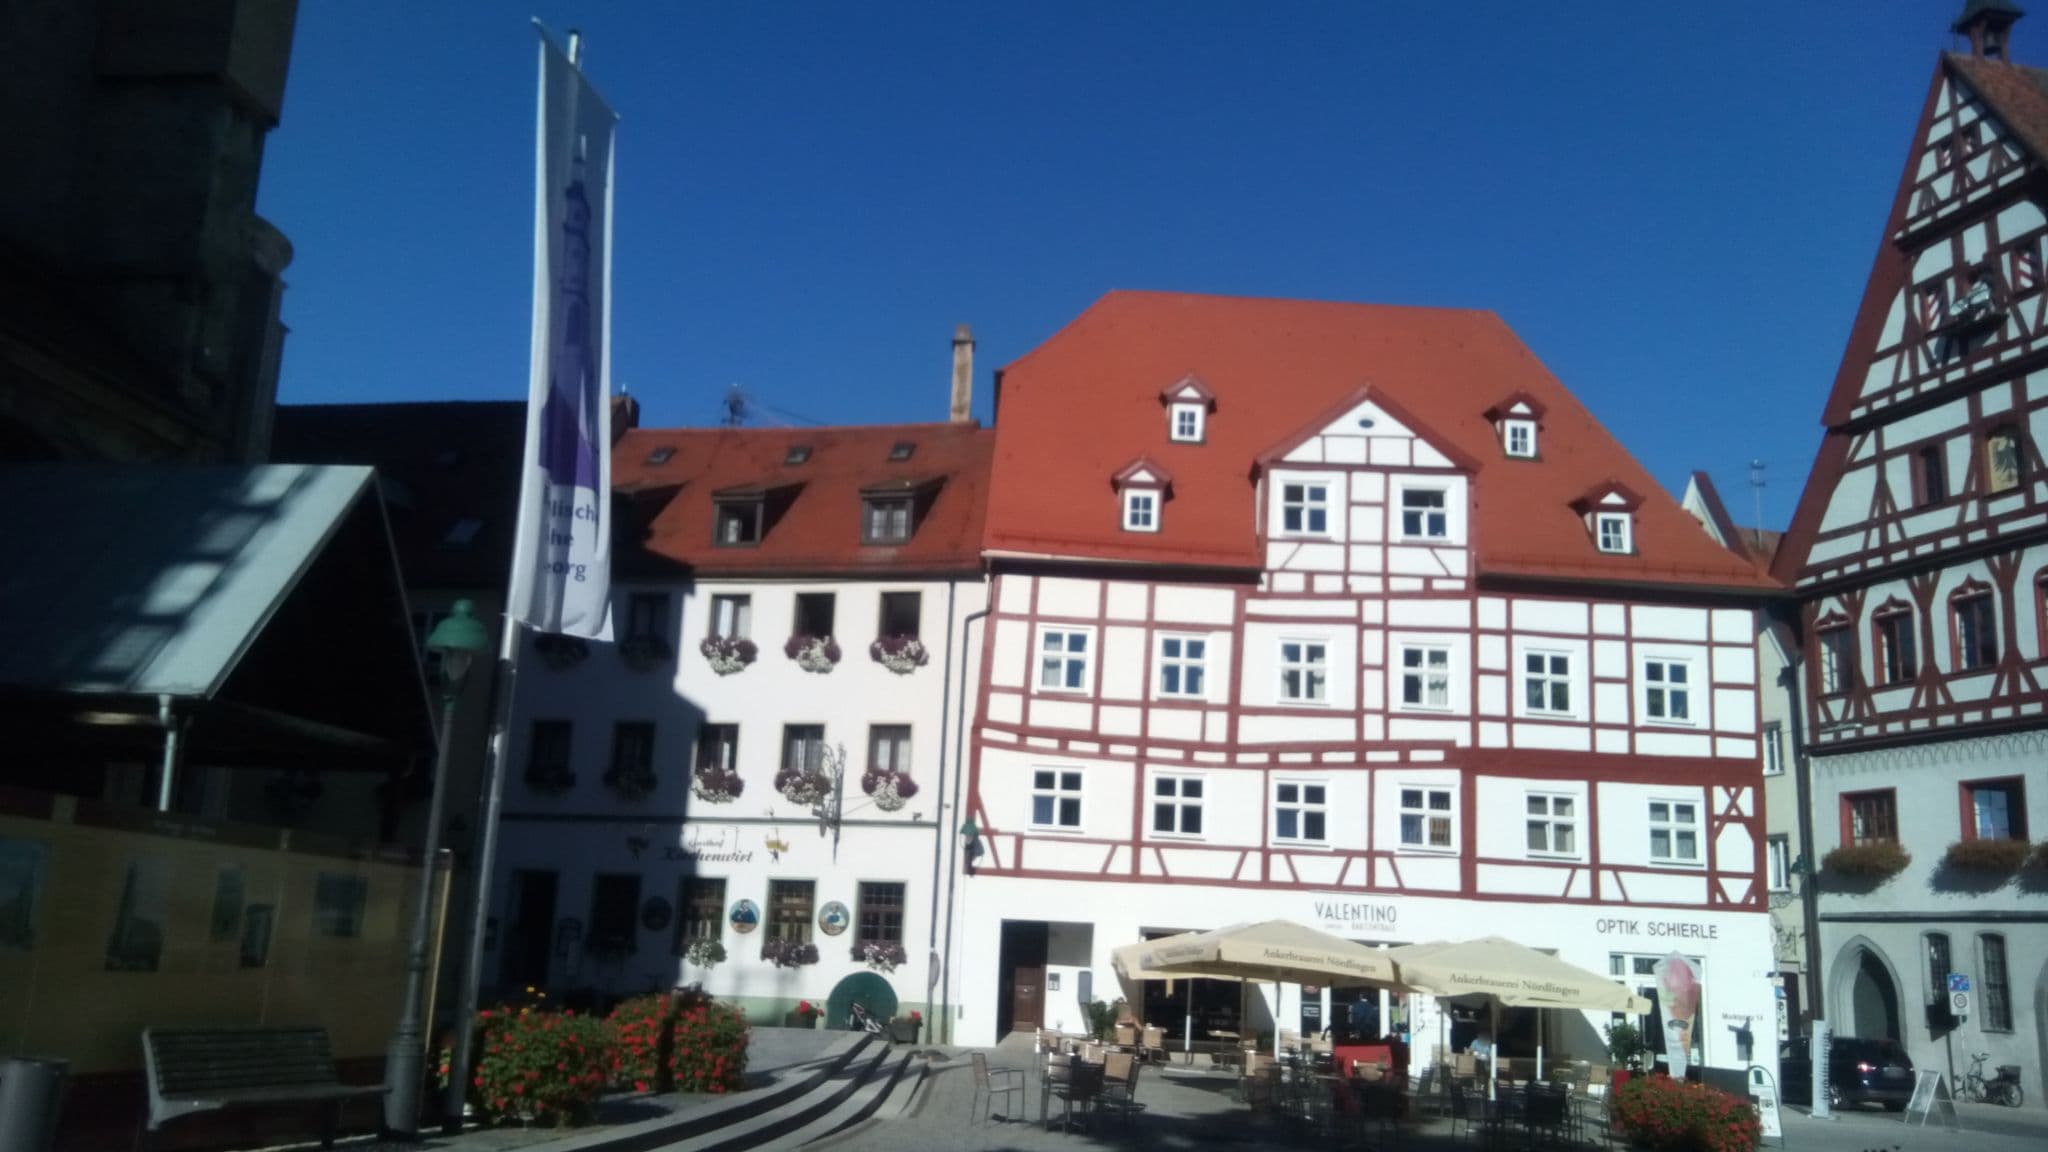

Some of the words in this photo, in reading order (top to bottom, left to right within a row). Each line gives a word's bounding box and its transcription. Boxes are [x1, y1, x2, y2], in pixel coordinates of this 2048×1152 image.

[1315, 901, 1397, 922] VALENTINO
[1596, 918, 1640, 935] OPTIK
[1647, 921, 1718, 939] SCHIERLE
